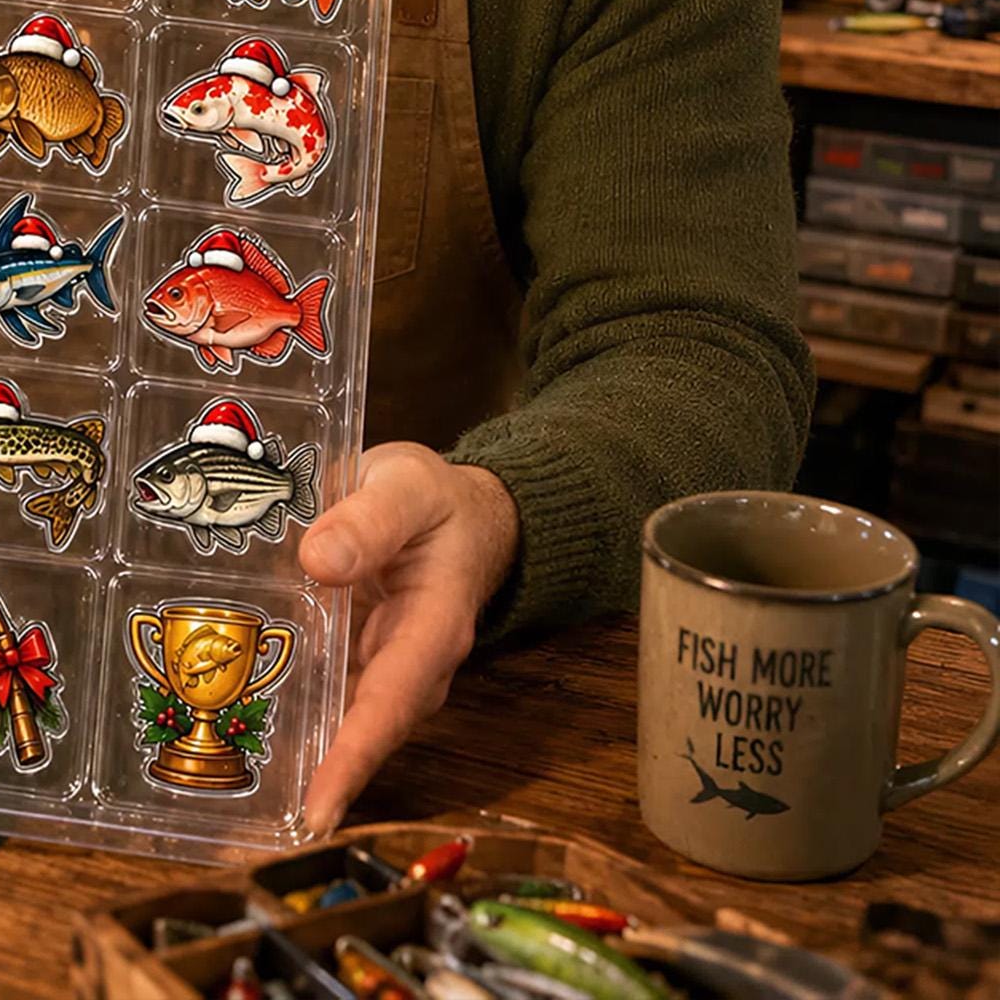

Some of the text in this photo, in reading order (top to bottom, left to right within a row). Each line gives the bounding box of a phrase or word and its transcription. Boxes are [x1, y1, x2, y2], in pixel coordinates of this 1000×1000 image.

[677, 626, 835, 688] FISH MORE
[698, 680, 803, 732] WORRY
[716, 733, 784, 776] LESS
